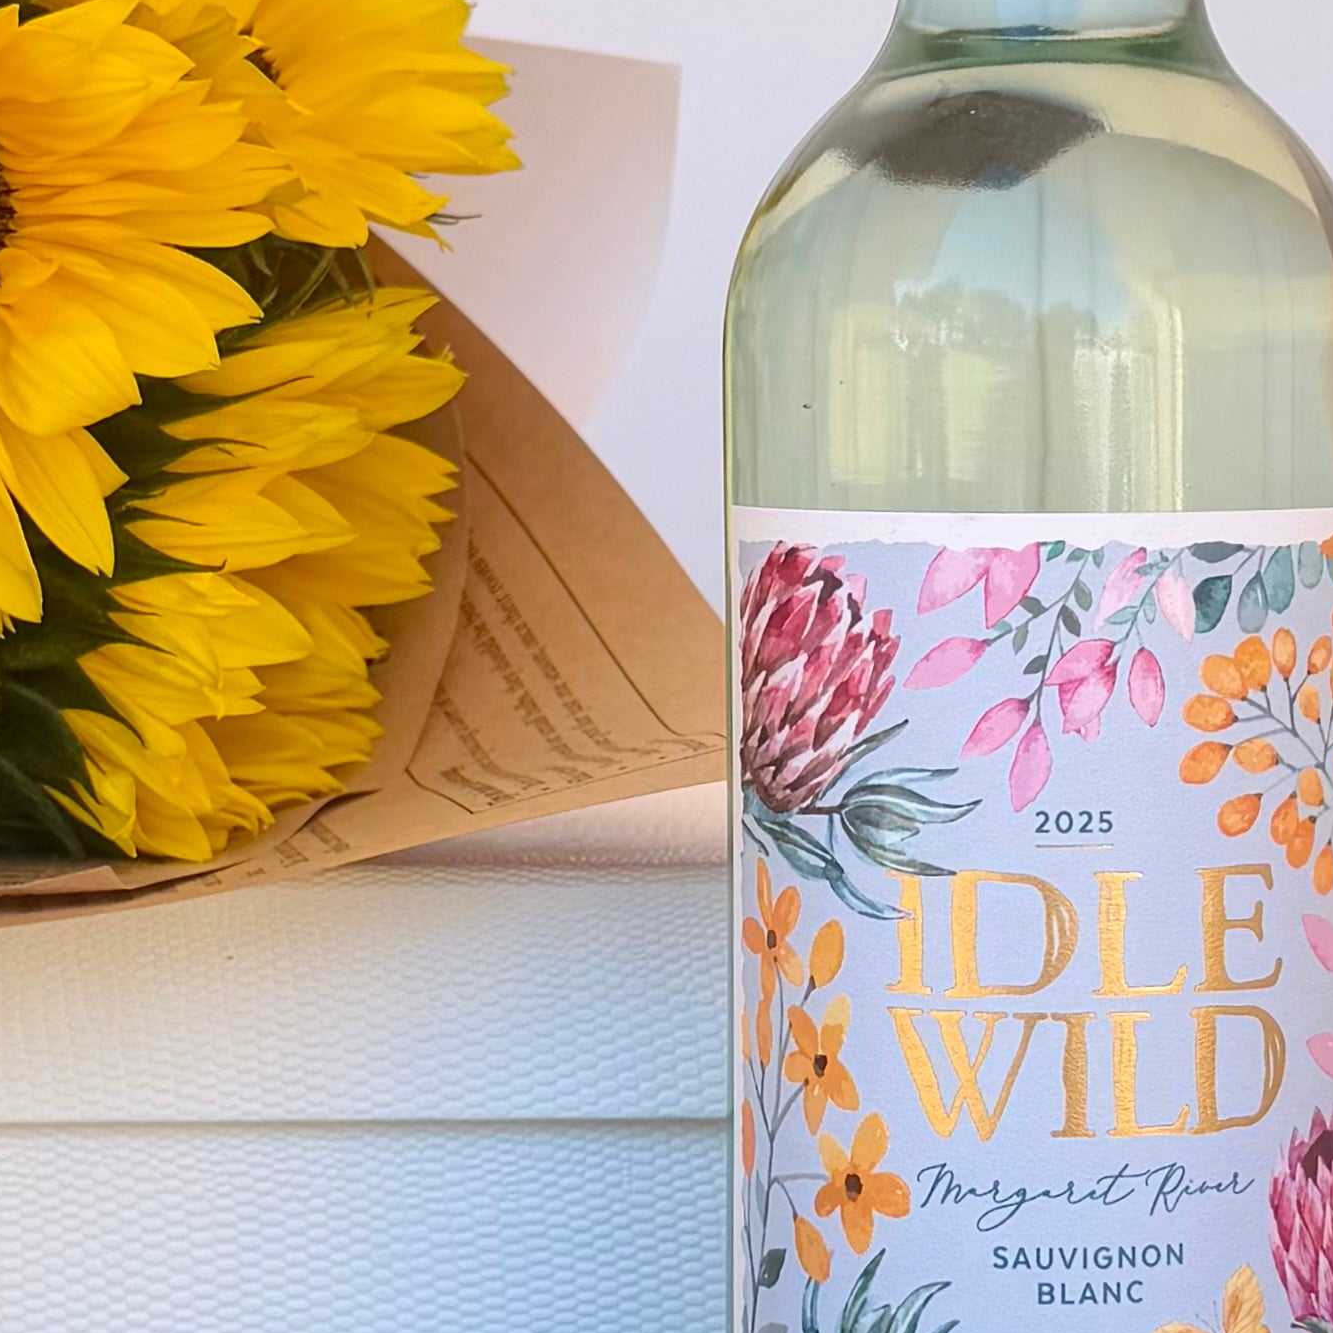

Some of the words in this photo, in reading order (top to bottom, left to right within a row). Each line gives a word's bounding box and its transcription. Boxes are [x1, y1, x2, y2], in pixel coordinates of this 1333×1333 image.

[1035, 811, 1113, 834] 2025
[884, 863, 1283, 998] IDLE
[886, 1005, 1286, 1142] WILD
[917, 1163, 1148, 1232] Margaret
[1145, 1162, 1255, 1216] River
[993, 1243, 1183, 1270] SAUVIGNON
[1038, 1280, 1143, 1305] BLANC
